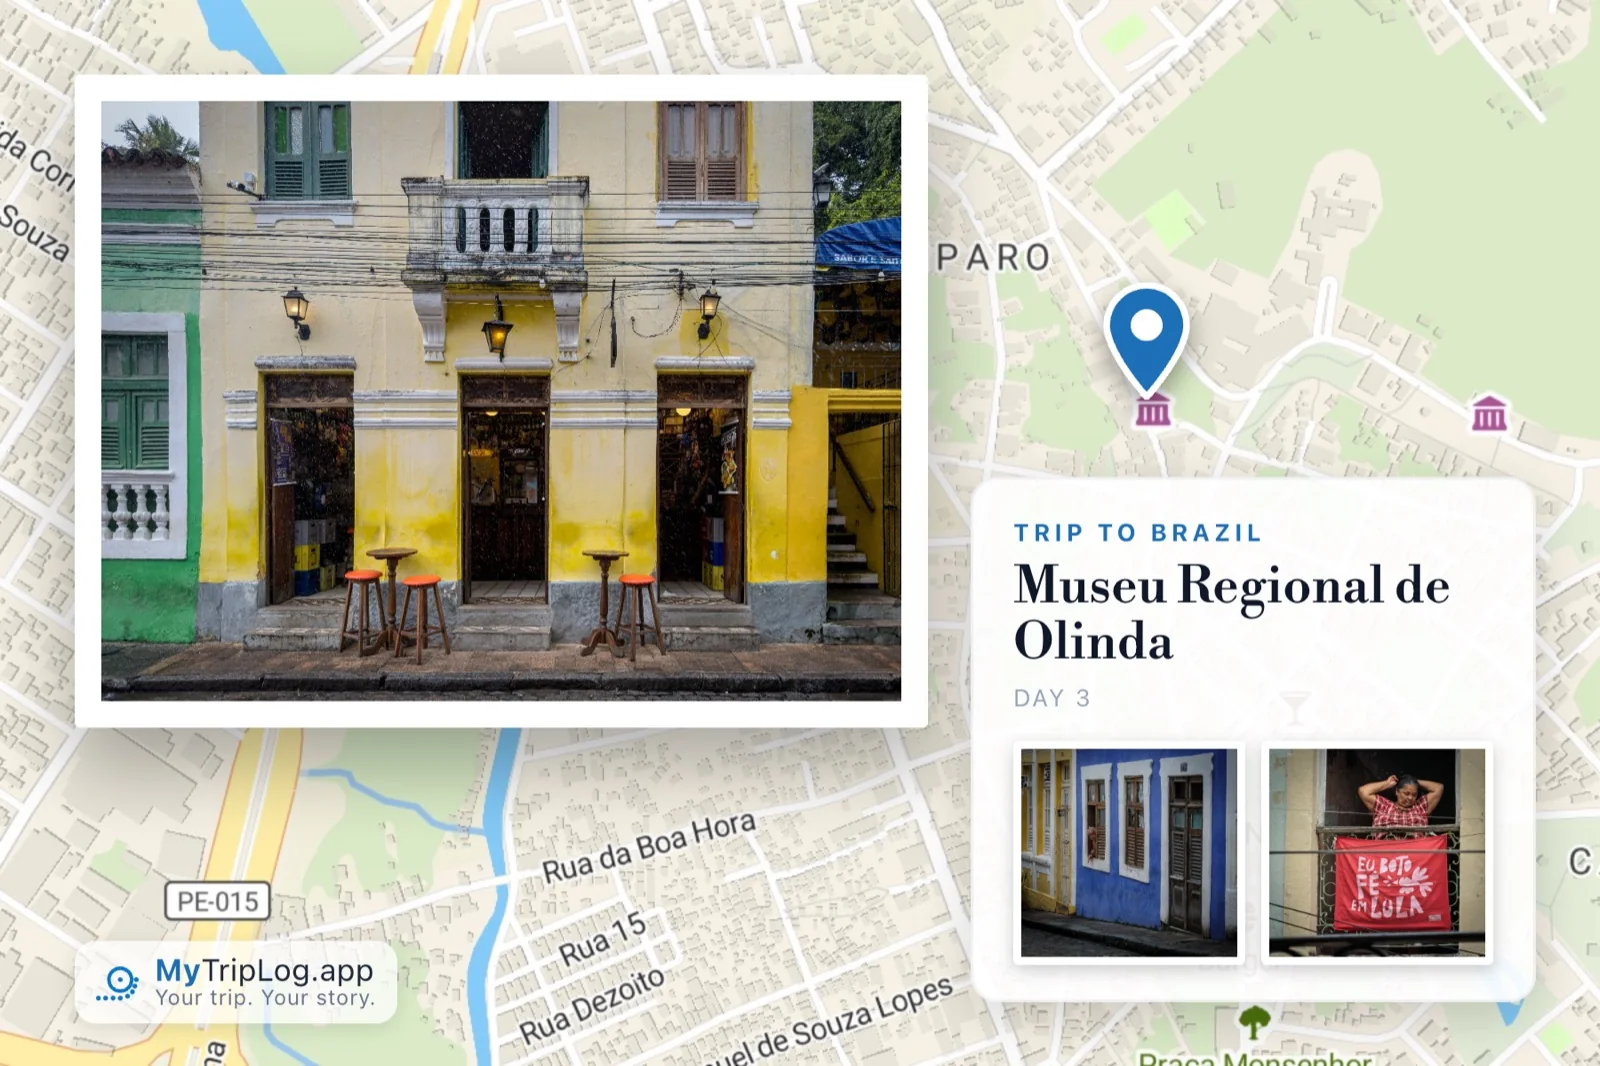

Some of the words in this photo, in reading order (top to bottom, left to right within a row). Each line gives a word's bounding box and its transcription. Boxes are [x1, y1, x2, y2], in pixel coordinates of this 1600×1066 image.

[0, 204, 70, 262] Souza
[938, 243, 1049, 271] PARO
[542, 857, 593, 884] Rua
[599, 844, 632, 869] da
[636, 831, 687, 859] Boa
[691, 814, 757, 843] Hora
[1358, 856, 1375, 872] EU
[1380, 855, 1412, 875] BOTO
[179, 891, 258, 912] PE-015
[1356, 870, 1379, 900] FÉ
[1351, 900, 1367, 912] EM
[1371, 896, 1423, 918] LULA
[559, 934, 610, 967] Rua
[612, 911, 647, 941] 15
[519, 1012, 571, 1045] Rua
[571, 969, 665, 1022] Dezoito
[758, 1032, 789, 1058] de
[792, 1007, 873, 1046] Souza
[874, 978, 954, 1019] Lopes
